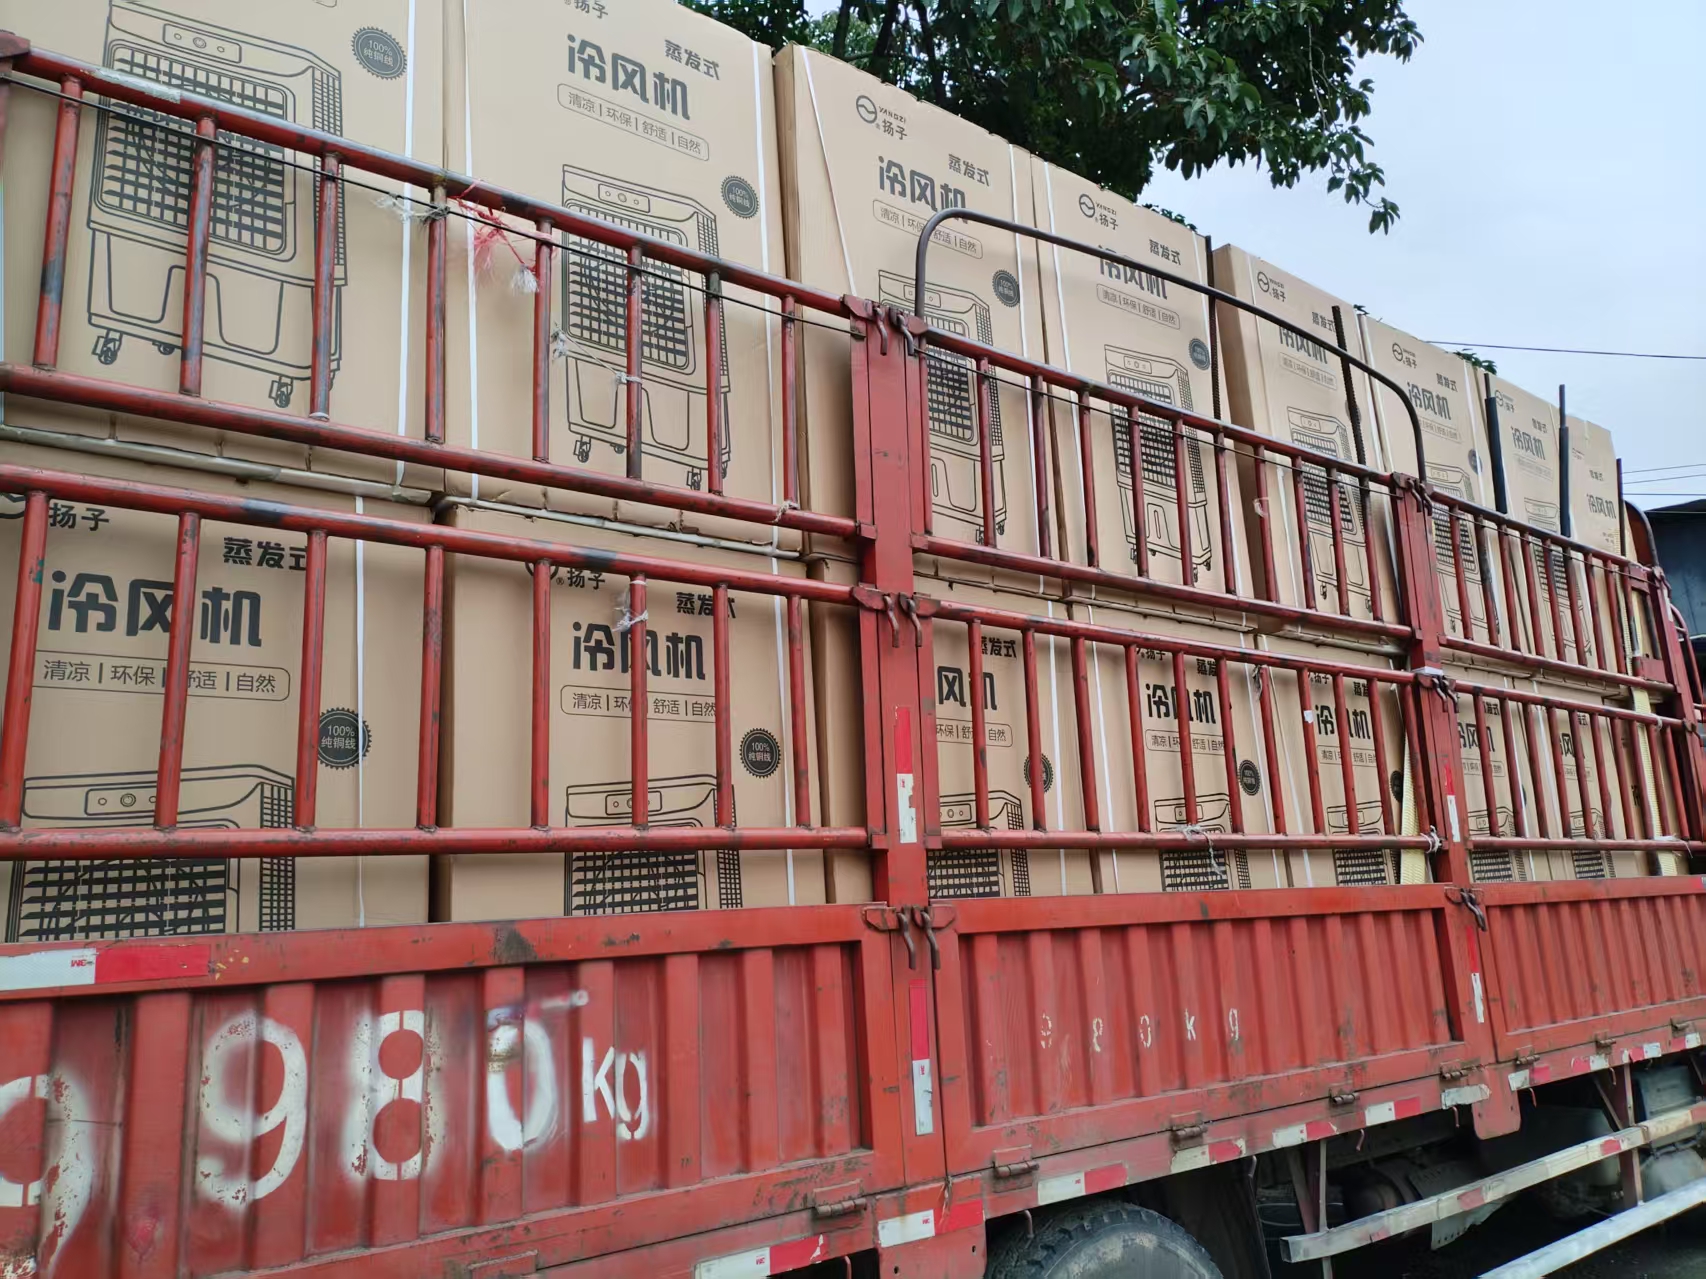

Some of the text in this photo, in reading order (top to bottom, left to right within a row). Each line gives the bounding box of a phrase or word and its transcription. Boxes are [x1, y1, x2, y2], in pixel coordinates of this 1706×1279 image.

[363, 47, 394, 67] 纯铜线
[369, 40, 393, 56] 100%
[664, 39, 720, 80] 蒸发式
[567, 33, 690, 120] 冷风机
[568, 92, 701, 155] 清凉 环保 舒适 自然
[879, 106, 906, 123] YANGZI
[881, 118, 907, 140] 扬子
[948, 153, 990, 187] 蒸发式
[878, 155, 968, 225] 冷风机
[880, 206, 899, 225] 清凉
[959, 237, 977, 254] 自然
[1099, 213, 1118, 230] 扬子
[1149, 239, 1181, 266] 蒸发式
[1407, 381, 1451, 420] 冷风机
[1511, 426, 1546, 460] 冷风机
[49, 503, 110, 531] 扬子
[48, 570, 262, 647] 冷风机
[43, 660, 91, 682] 清凉
[110, 664, 155, 686] 环保
[236, 672, 276, 693] 自然
[572, 692, 602, 711] 清凉
[653, 698, 680, 716] 舒适
[321, 736, 356, 750] 纯铜线
[328, 725, 355, 737] 100%
[988, 728, 1006, 742] 自然
[752, 742, 770, 752] 100%
